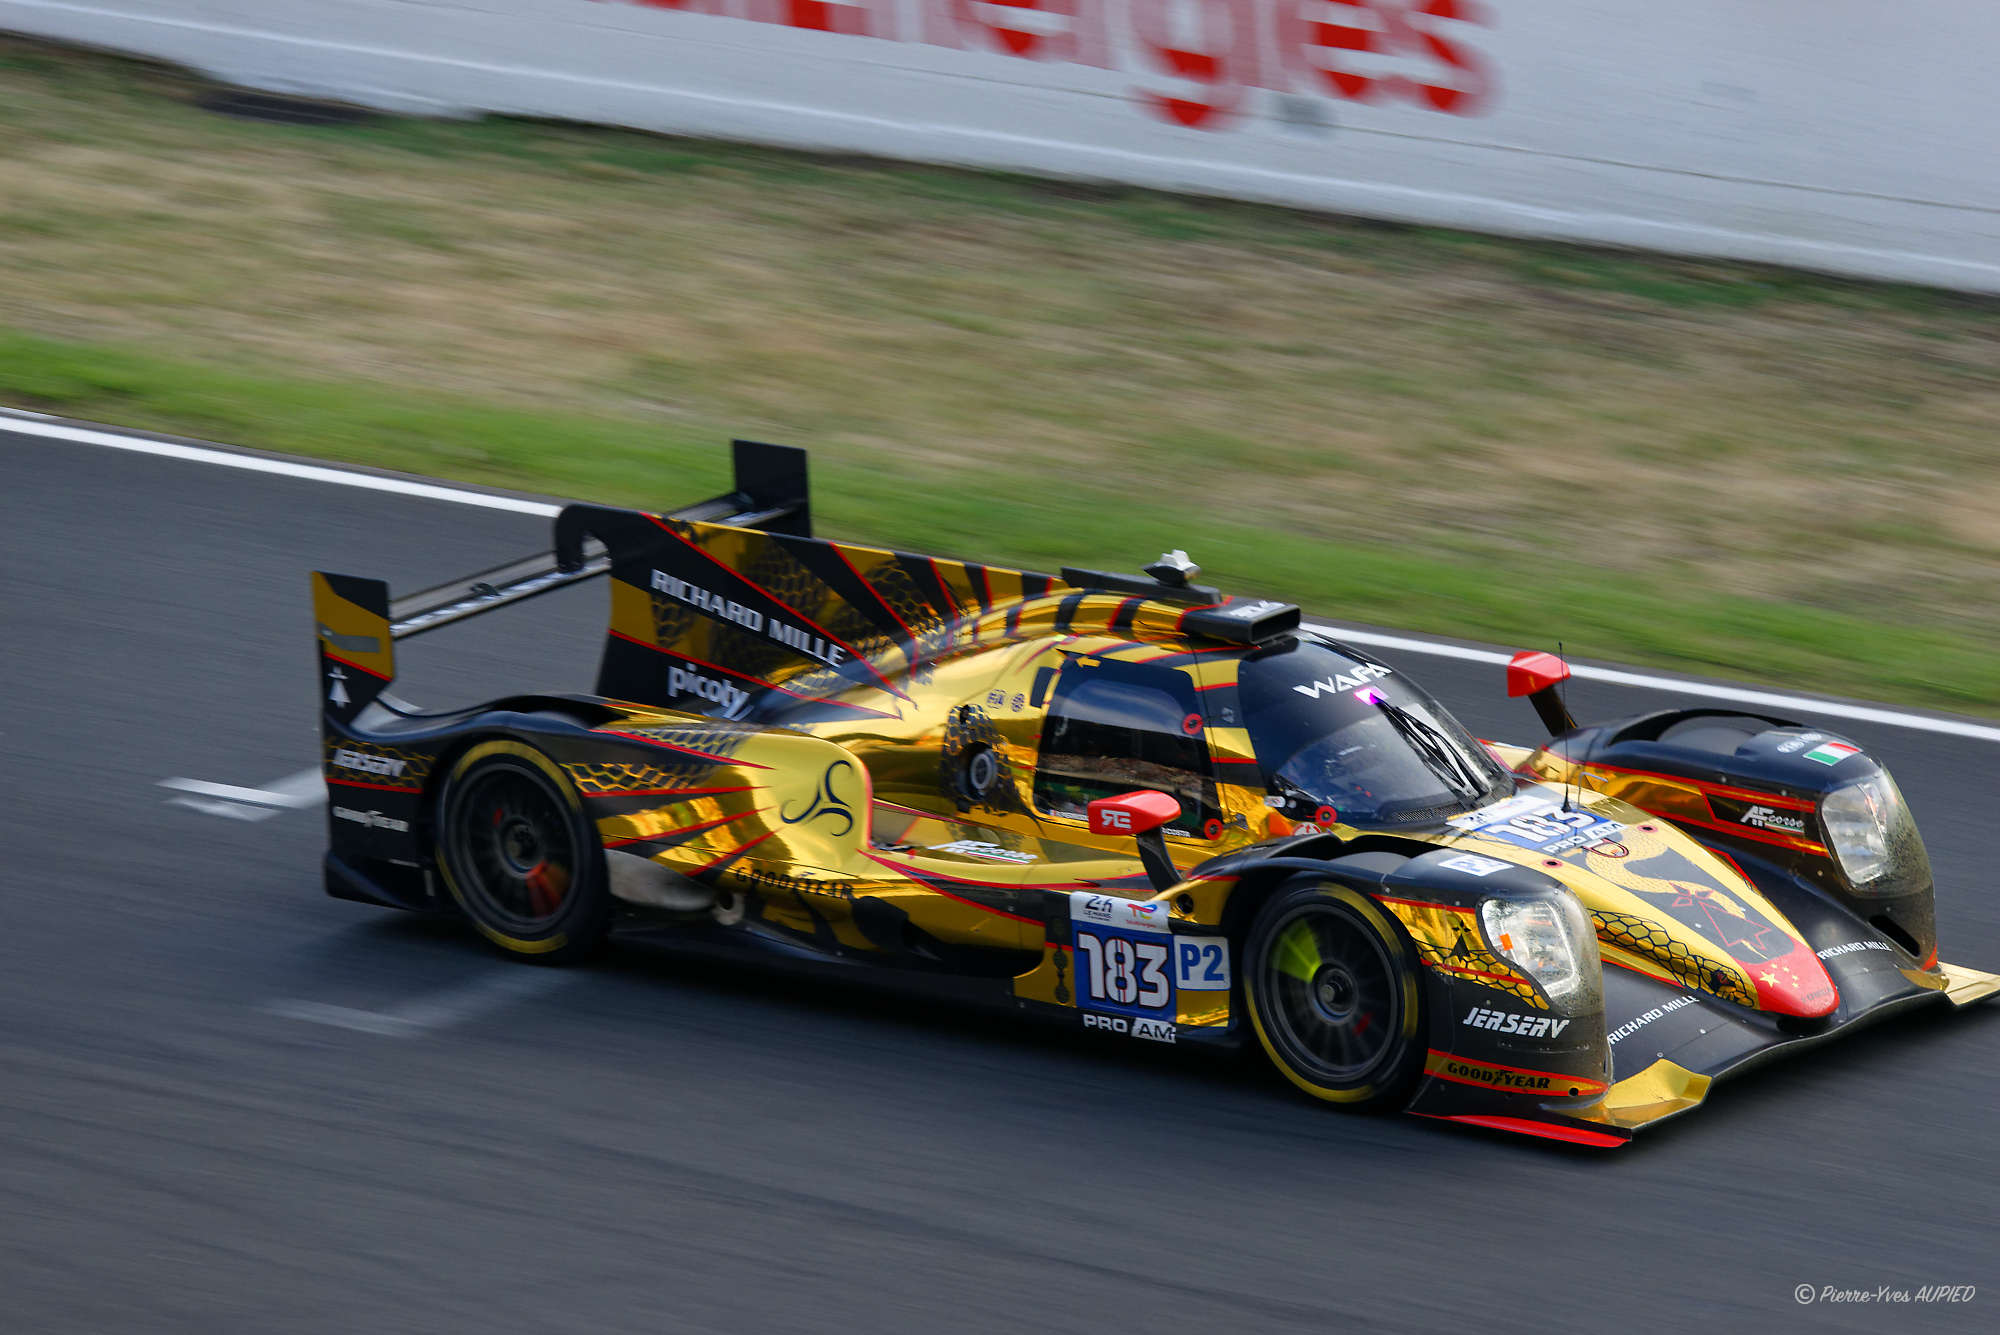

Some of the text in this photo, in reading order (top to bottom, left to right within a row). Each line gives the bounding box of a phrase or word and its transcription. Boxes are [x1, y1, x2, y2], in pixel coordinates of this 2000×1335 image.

[651, 568, 848, 668] RICHARD MILLE
[668, 662, 750, 720] picoty
[1541, 820, 1624, 855] PRO AM
[1179, 943, 1226, 983] P2
[1816, 940, 1893, 960] RICHARD MILL
[1077, 932, 1171, 1009] 183
[1083, 1013, 1176, 1041] PRO AM
[1463, 1007, 1570, 1039] JERSERV
[1606, 995, 1700, 1045] RICHARD MILL
[1447, 1061, 1551, 1090] GOODYEAR
